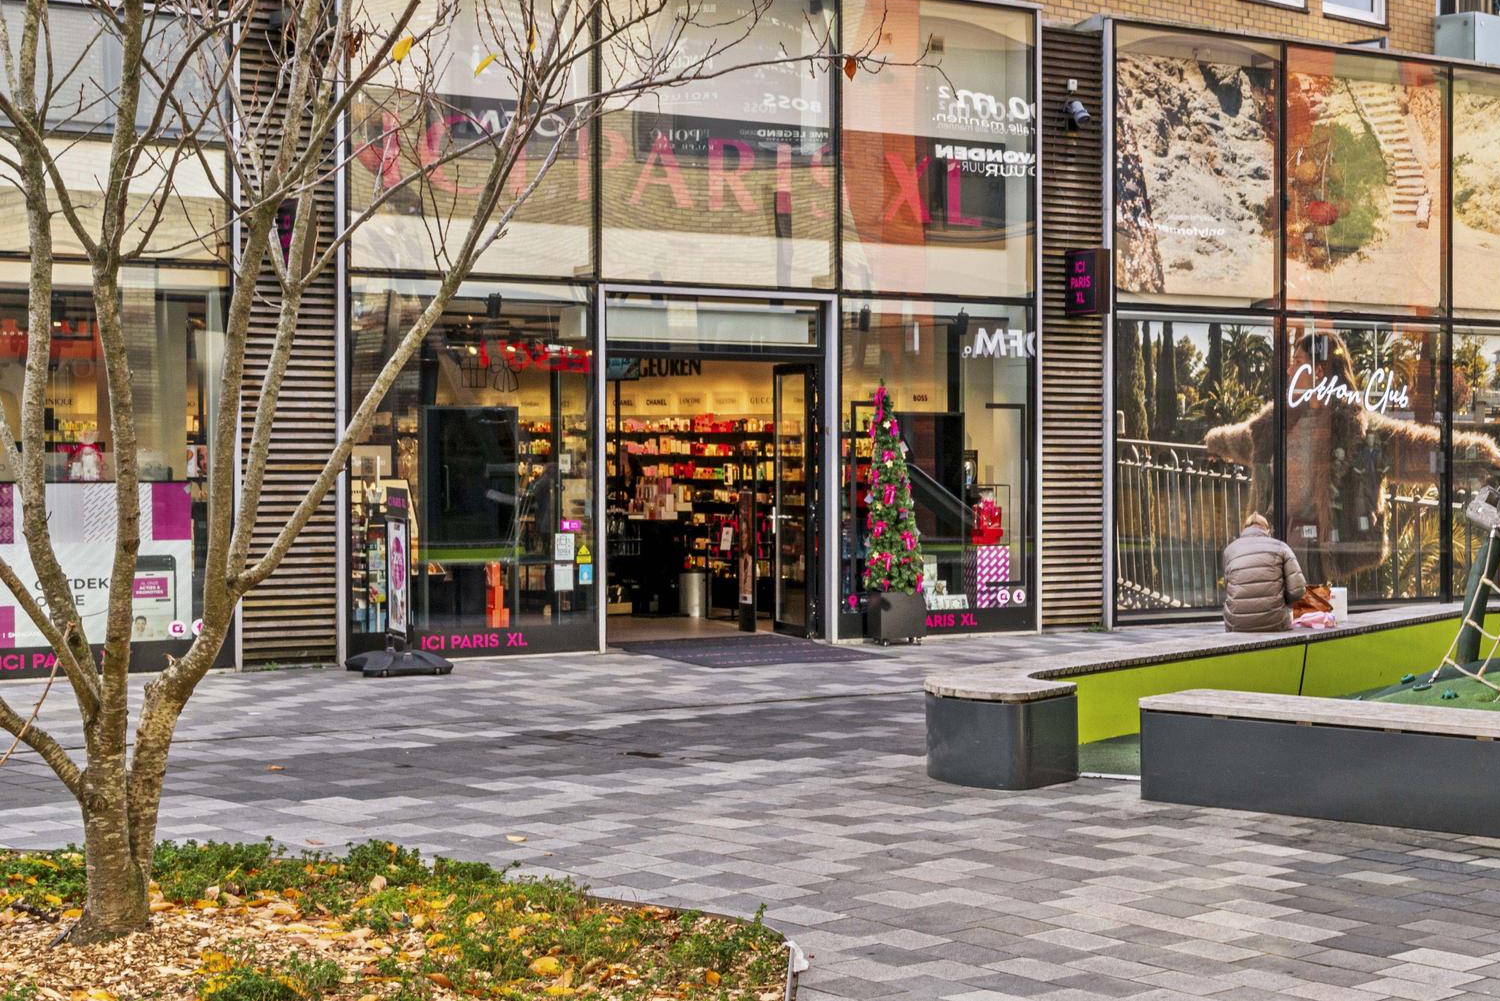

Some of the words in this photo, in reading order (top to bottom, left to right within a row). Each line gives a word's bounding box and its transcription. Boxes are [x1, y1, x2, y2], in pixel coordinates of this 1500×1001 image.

[884, 152, 982, 228] XL
[1070, 275, 1091, 288] PARIS
[1288, 363, 1361, 408] Cotton
[1364, 367, 1409, 414] Club
[612, 398, 633, 407] CANEL
[645, 398, 667, 406] CHANEL
[912, 394, 928, 402] BOSS
[925, 614, 954, 628] ARIS
[960, 613, 978, 626] XL
[421, 635, 445, 650] ICI
[450, 633, 499, 649] PARIS
[506, 632, 528, 647] XL
